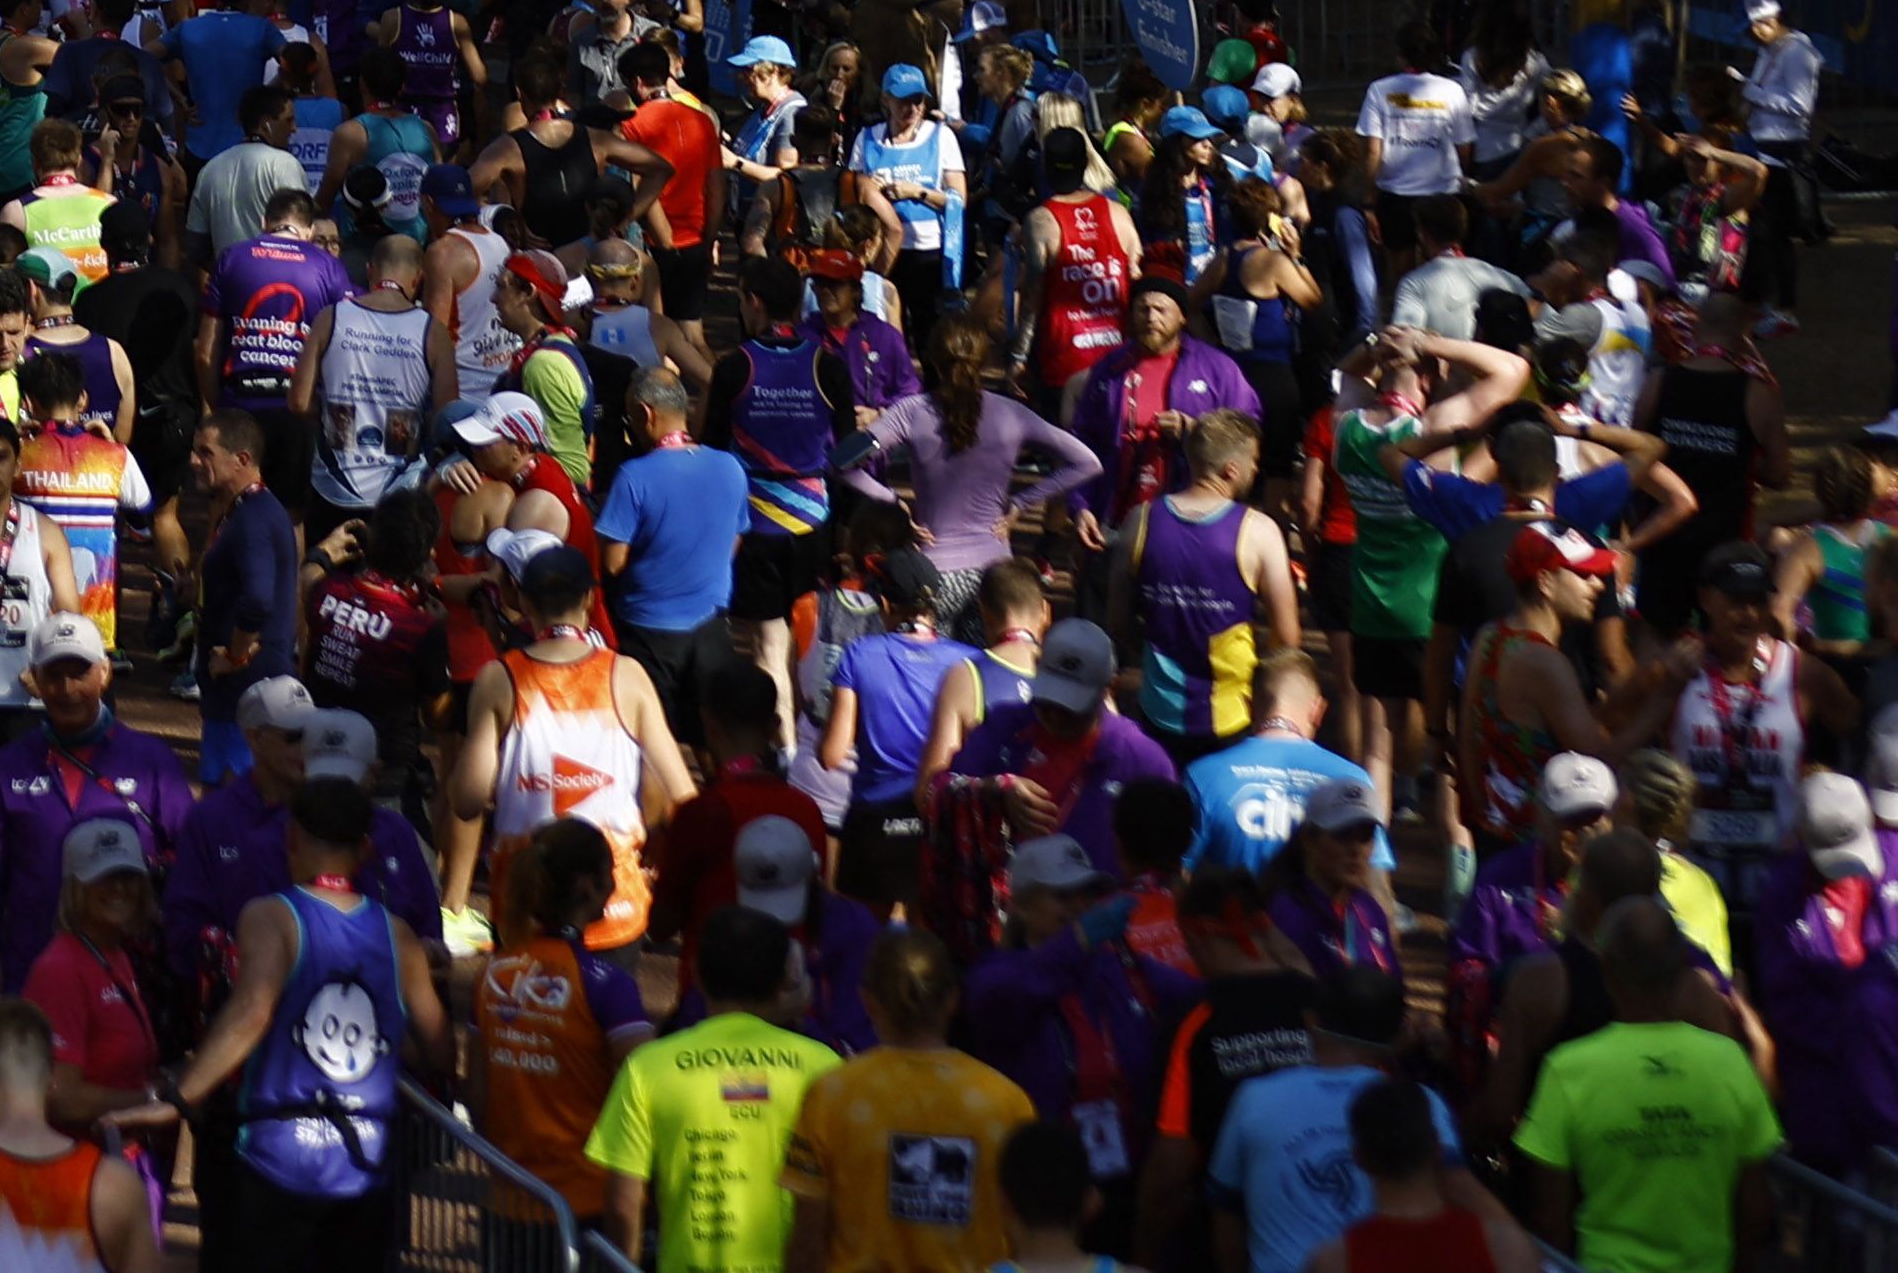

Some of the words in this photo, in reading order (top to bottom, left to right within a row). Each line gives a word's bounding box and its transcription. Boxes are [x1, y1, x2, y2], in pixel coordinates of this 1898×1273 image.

[1067, 244, 1095, 261] The
[1062, 258, 1104, 282] race
[1107, 255, 1122, 275] is
[1083, 281, 1120, 303] on
[345, 326, 393, 344] Running
[396, 335, 412, 347] for
[239, 350, 300, 367] cancer
[341, 338, 376, 352] Clark
[379, 345, 418, 360] Geddes
[752, 384, 813, 400] Together
[23, 469, 116, 490] THAILAND
[333, 624, 357, 642] RUN
[319, 635, 362, 660] SWEAT
[319, 649, 357, 673] SMILE
[314, 662, 357, 686] REPEAT
[516, 772, 550, 792] MS
[553, 770, 605, 789] Society
[487, 955, 572, 1009] Kika
[1211, 1028, 1308, 1055] Supporting
[675, 1047, 801, 1072] GIOVANNI
[729, 1104, 761, 1120] ECU
